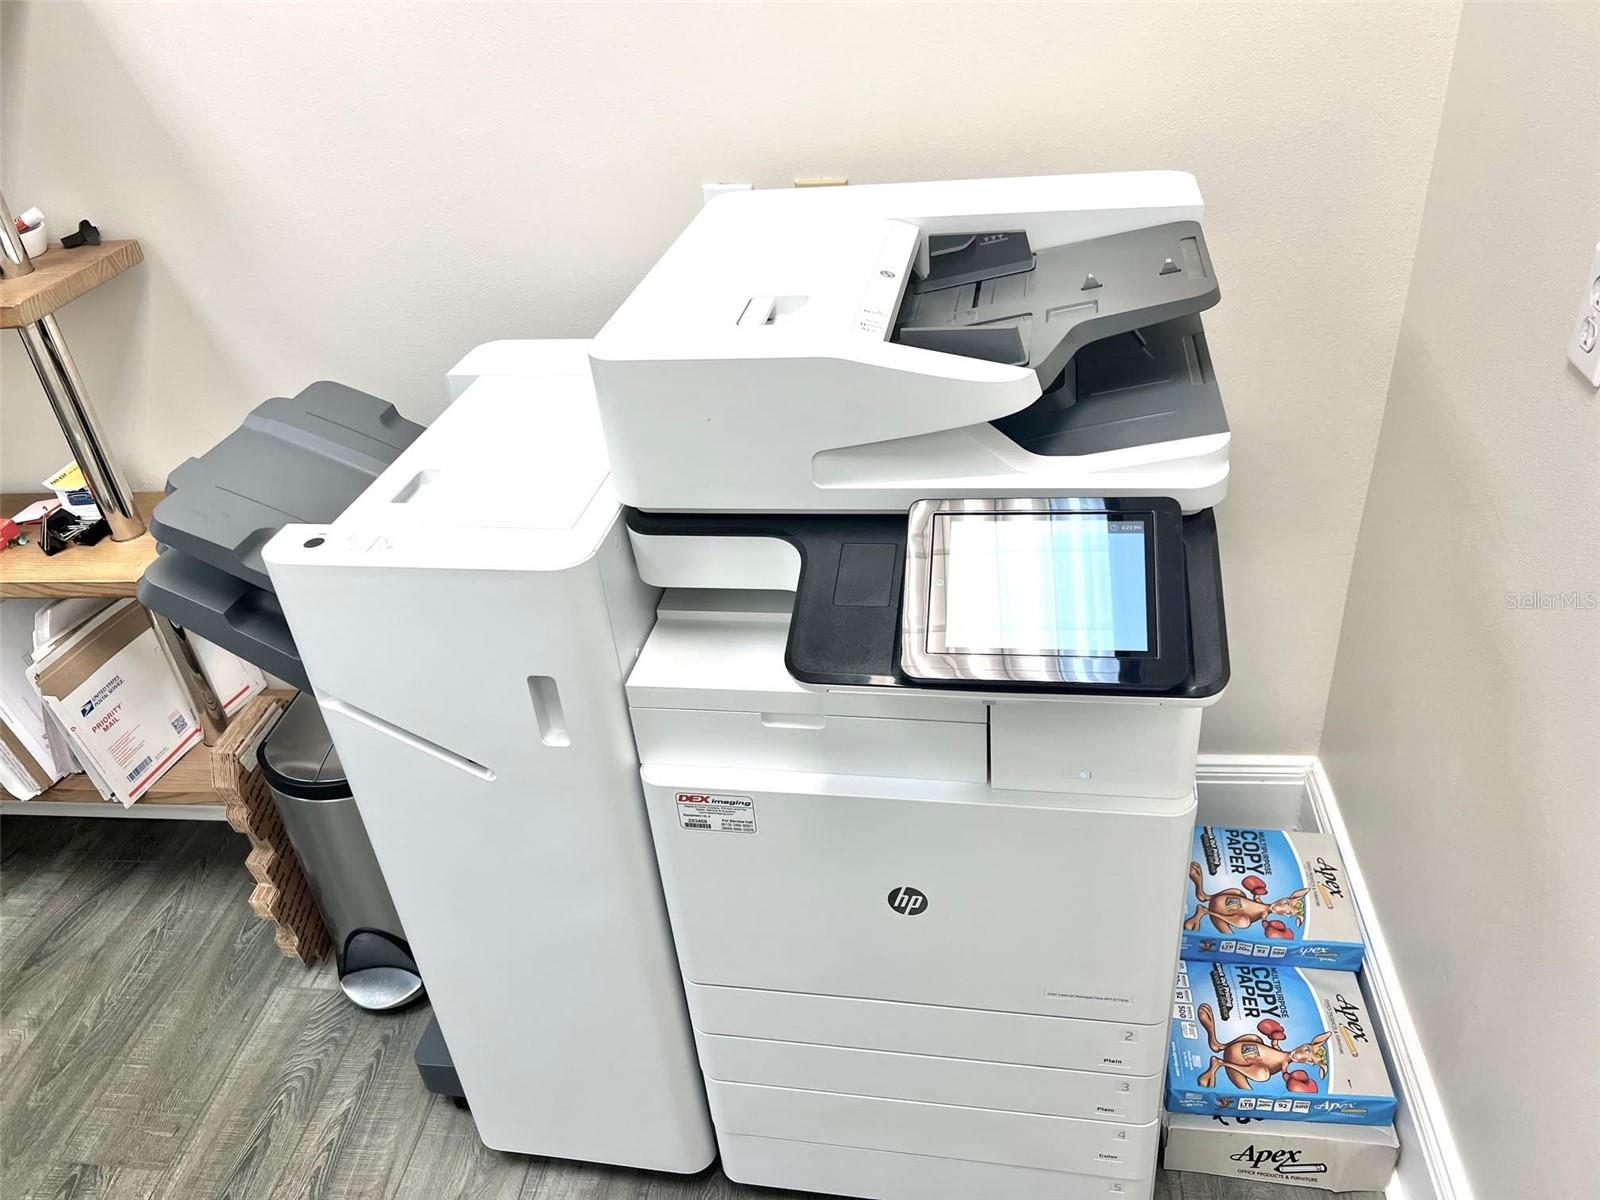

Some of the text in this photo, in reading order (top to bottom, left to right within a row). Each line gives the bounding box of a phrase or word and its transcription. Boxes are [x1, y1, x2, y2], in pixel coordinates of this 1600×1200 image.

[92, 687, 107, 701] UNITED
[92, 703, 122, 733] PRIORITY
[102, 717, 120, 733] MAIL
[678, 794, 710, 803] DEX
[1225, 829, 1246, 875] PAPER
[1241, 830, 1264, 875] COPY
[1258, 831, 1273, 876] MULTIPURPOSE
[1314, 856, 1344, 899] Apex
[892, 886, 924, 915] hp
[1175, 991, 1184, 999] 92
[1235, 966, 1260, 1018] PAPER
[1251, 966, 1281, 1018] COPY
[1270, 967, 1289, 1018] MULTIPURPOSE
[1177, 1005, 1187, 1018] 500
[1333, 993, 1369, 1043] Apex
[1124, 1031, 1134, 1041] 2
[1121, 1082, 1130, 1092] 3
[1117, 1131, 1126, 1139] 4
[1230, 1144, 1302, 1169] Apex
[1113, 1183, 1122, 1192] 5
[1237, 1168, 1256, 1176] OFFICE
[1256, 1171, 1284, 1179] PRODUCTS
[1290, 1175, 1318, 1183] FURNITURE
